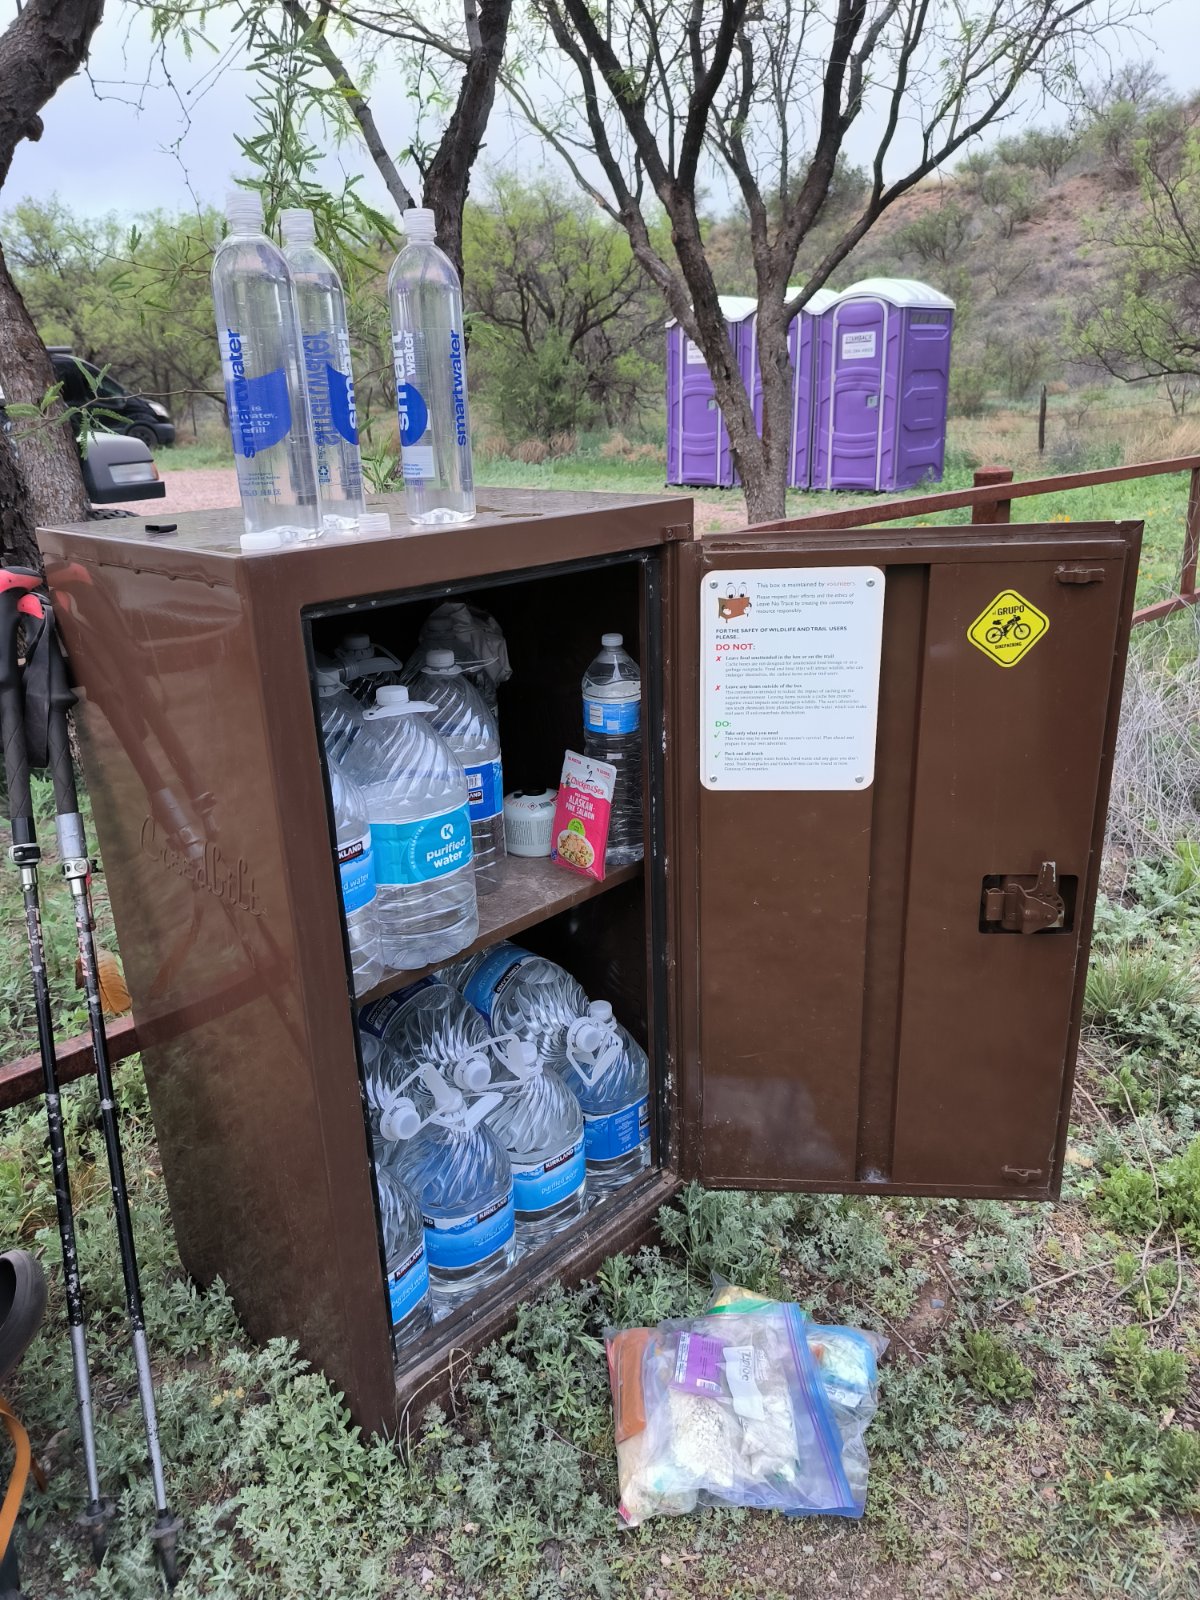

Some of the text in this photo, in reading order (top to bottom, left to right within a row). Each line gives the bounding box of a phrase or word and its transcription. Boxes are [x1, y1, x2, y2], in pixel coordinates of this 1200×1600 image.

[404, 330, 416, 376] water
[450, 330, 466, 446] smartwater
[998, 605, 1024, 616] GRUPO
[569, 795, 593, 811] ALASKAN
[338, 844, 362, 859] KLAND
[426, 836, 465, 862] purified
[433, 851, 463, 869] water
[545, 1148, 573, 1169] KIRKLAND
[479, 1198, 508, 1218] KIRKLAND
[396, 1247, 423, 1277] KIRKLAND
